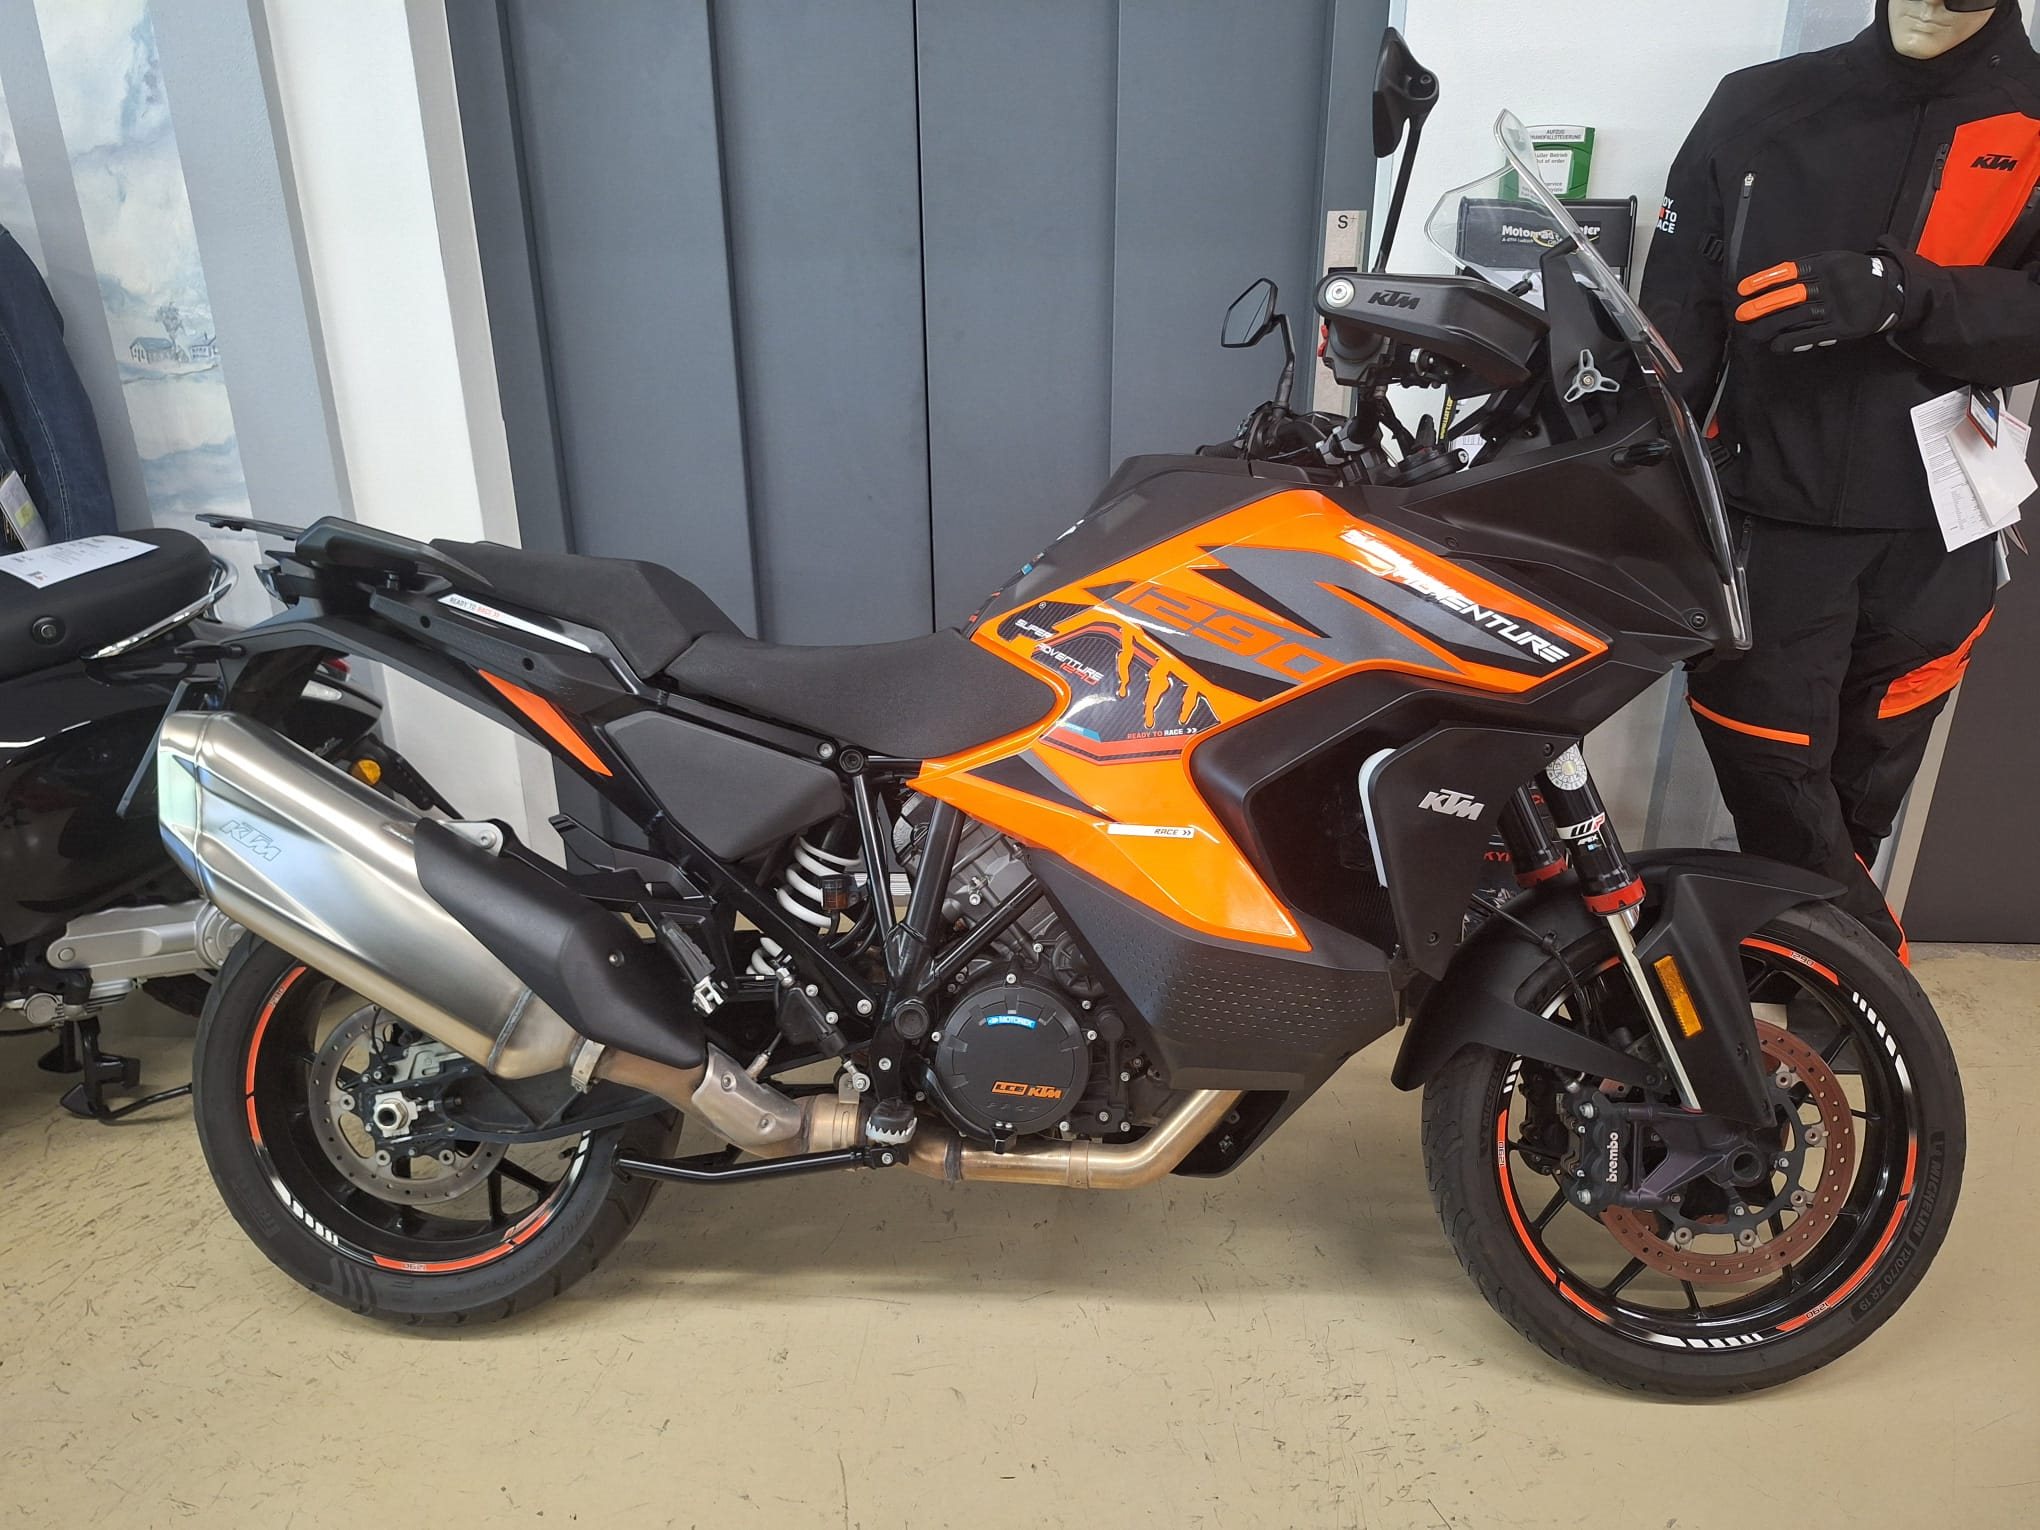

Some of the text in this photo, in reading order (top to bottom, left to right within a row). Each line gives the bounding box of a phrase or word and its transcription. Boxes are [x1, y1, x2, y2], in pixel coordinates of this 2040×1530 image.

[1970, 153, 2018, 171] KTM
[1337, 214, 1349, 229] S
[1656, 219, 1675, 234] ACE
[1367, 289, 1421, 310] KTM
[1127, 728, 1183, 740] READY TO RACE
[1417, 788, 1485, 821] KTM
[219, 819, 282, 862] KTM
[1153, 827, 1180, 836] RACE
[1606, 1131, 1619, 1183] brembo
[1913, 1161, 1945, 1237] MICHELIN
